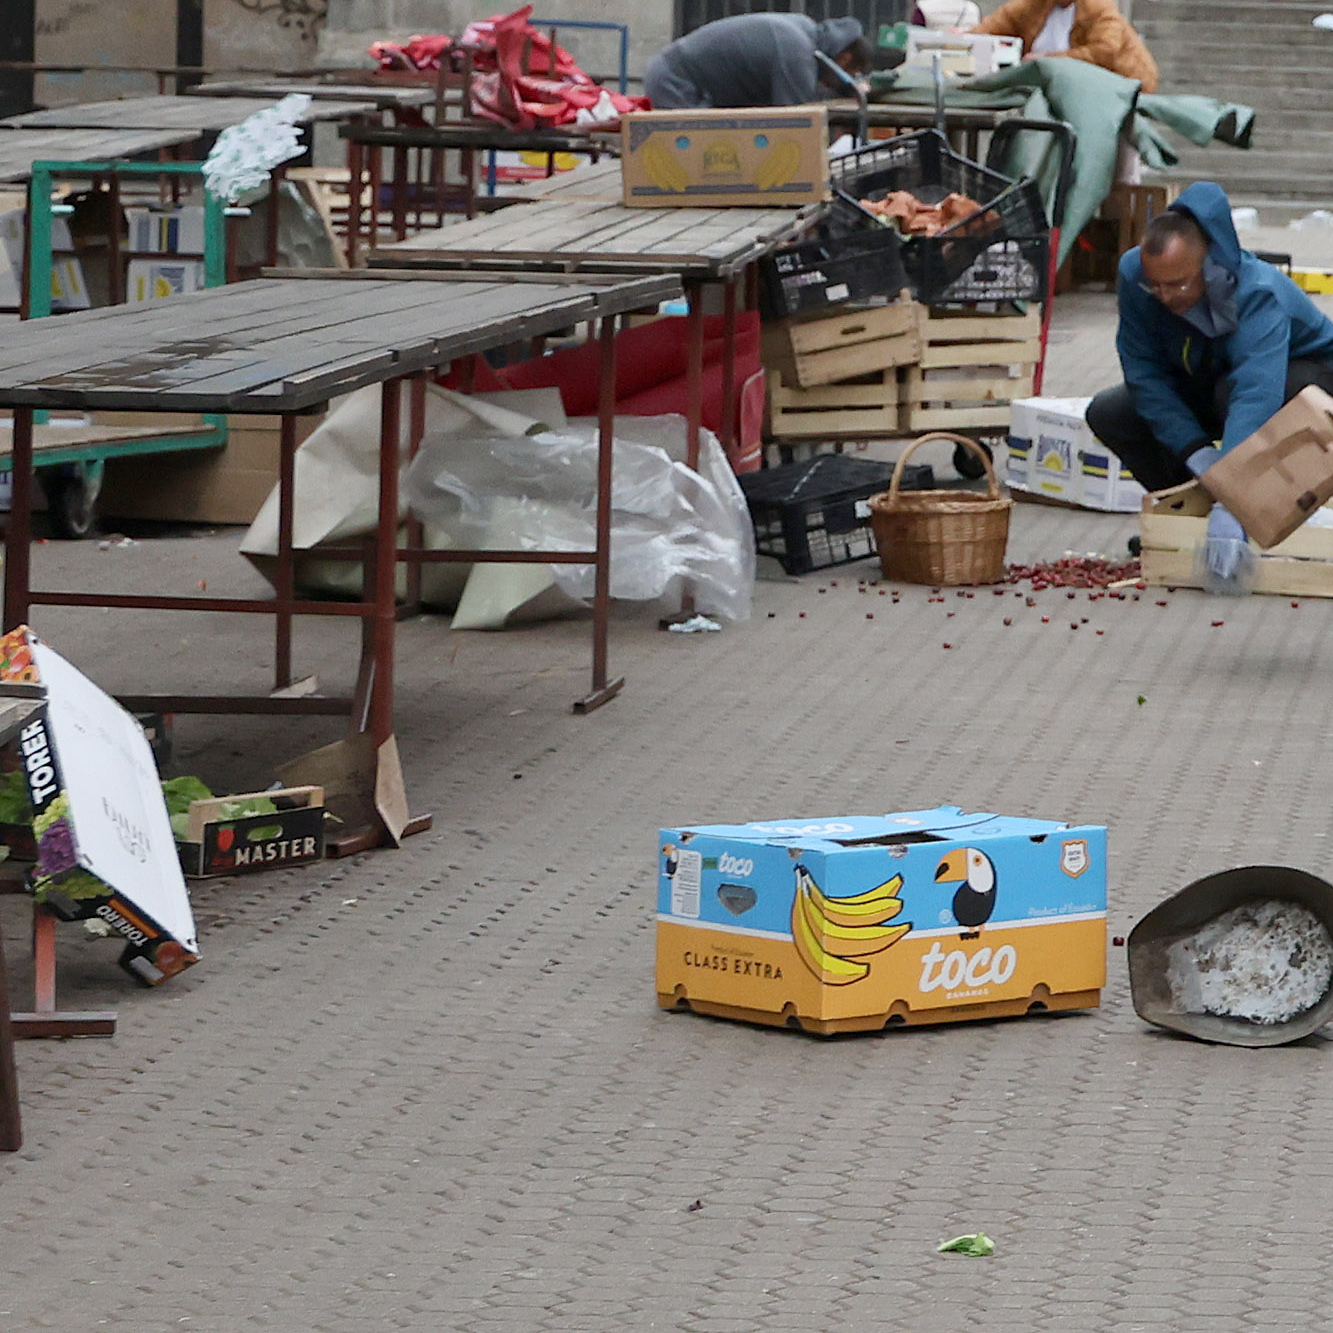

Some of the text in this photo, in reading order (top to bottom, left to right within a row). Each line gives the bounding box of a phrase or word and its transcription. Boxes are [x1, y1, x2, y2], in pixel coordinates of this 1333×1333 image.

[234, 836, 317, 867] MASTER
[718, 851, 755, 877] toco
[96, 904, 150, 948] TORERO
[683, 951, 783, 980] CLASS EXTRA
[918, 941, 1018, 994] toco
